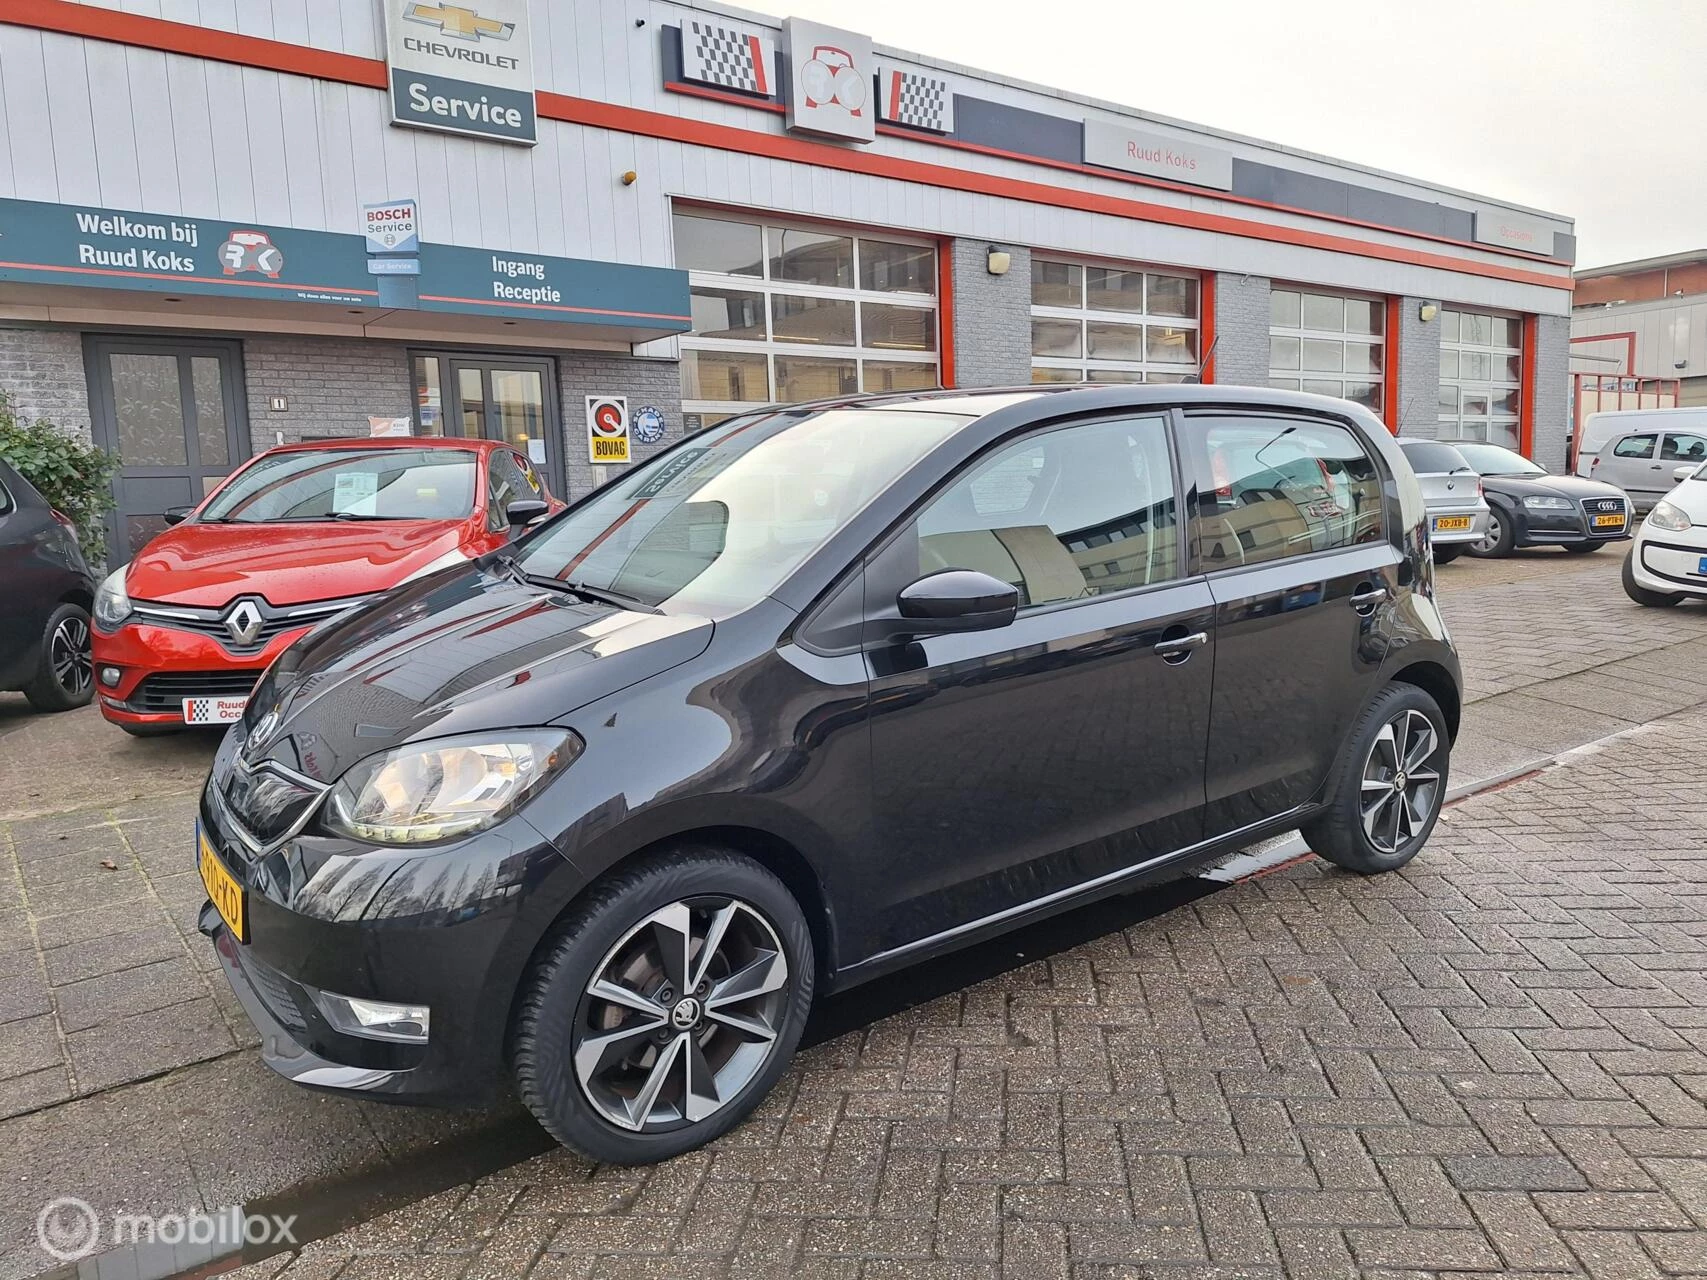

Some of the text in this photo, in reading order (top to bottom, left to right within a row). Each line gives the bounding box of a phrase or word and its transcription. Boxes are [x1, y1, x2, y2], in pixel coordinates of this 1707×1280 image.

[403, 37, 519, 70] CHEVROLET
[408, 82, 522, 128] Service
[1127, 141, 1197, 170] Ruud Koks
[367, 207, 411, 222] BOSCH
[76, 212, 199, 248] Welkom bij
[367, 222, 412, 233] Service
[79, 243, 196, 273] Ruud Koks
[492, 255, 546, 281] Ingang
[493, 280, 561, 304] Receptie
[596, 441, 625, 456] BOVAG
[217, 701, 245, 710] Ruud
[220, 711, 241, 719] Occ
